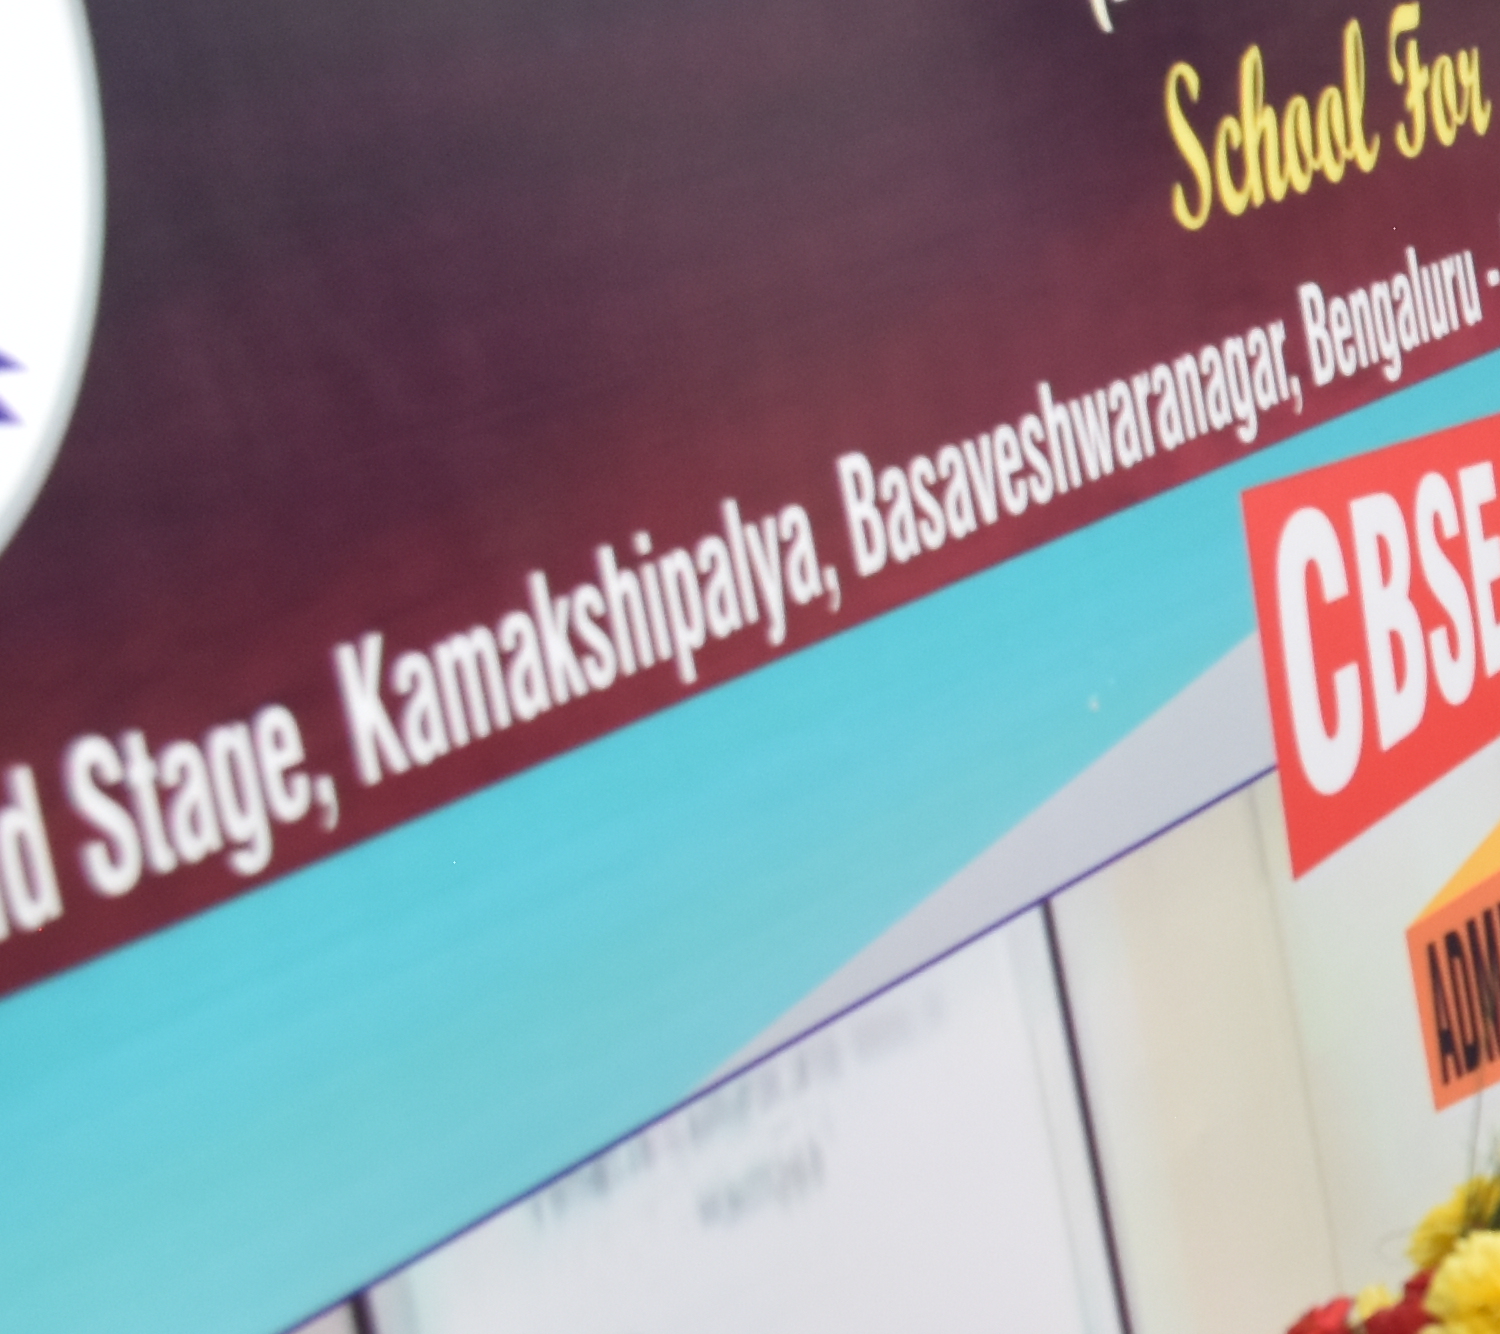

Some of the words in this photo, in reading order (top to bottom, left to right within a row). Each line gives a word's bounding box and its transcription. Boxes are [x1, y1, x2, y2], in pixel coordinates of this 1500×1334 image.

[1163, 17, 1381, 231] School
[1388, 1, 1492, 159] For
[64, 703, 342, 898] Stage,
[331, 495, 843, 787] Kamakshipalya,
[836, 318, 1306, 578] Basaveshwaranagar,
[1297, 246, 1484, 389] Bengaluru
